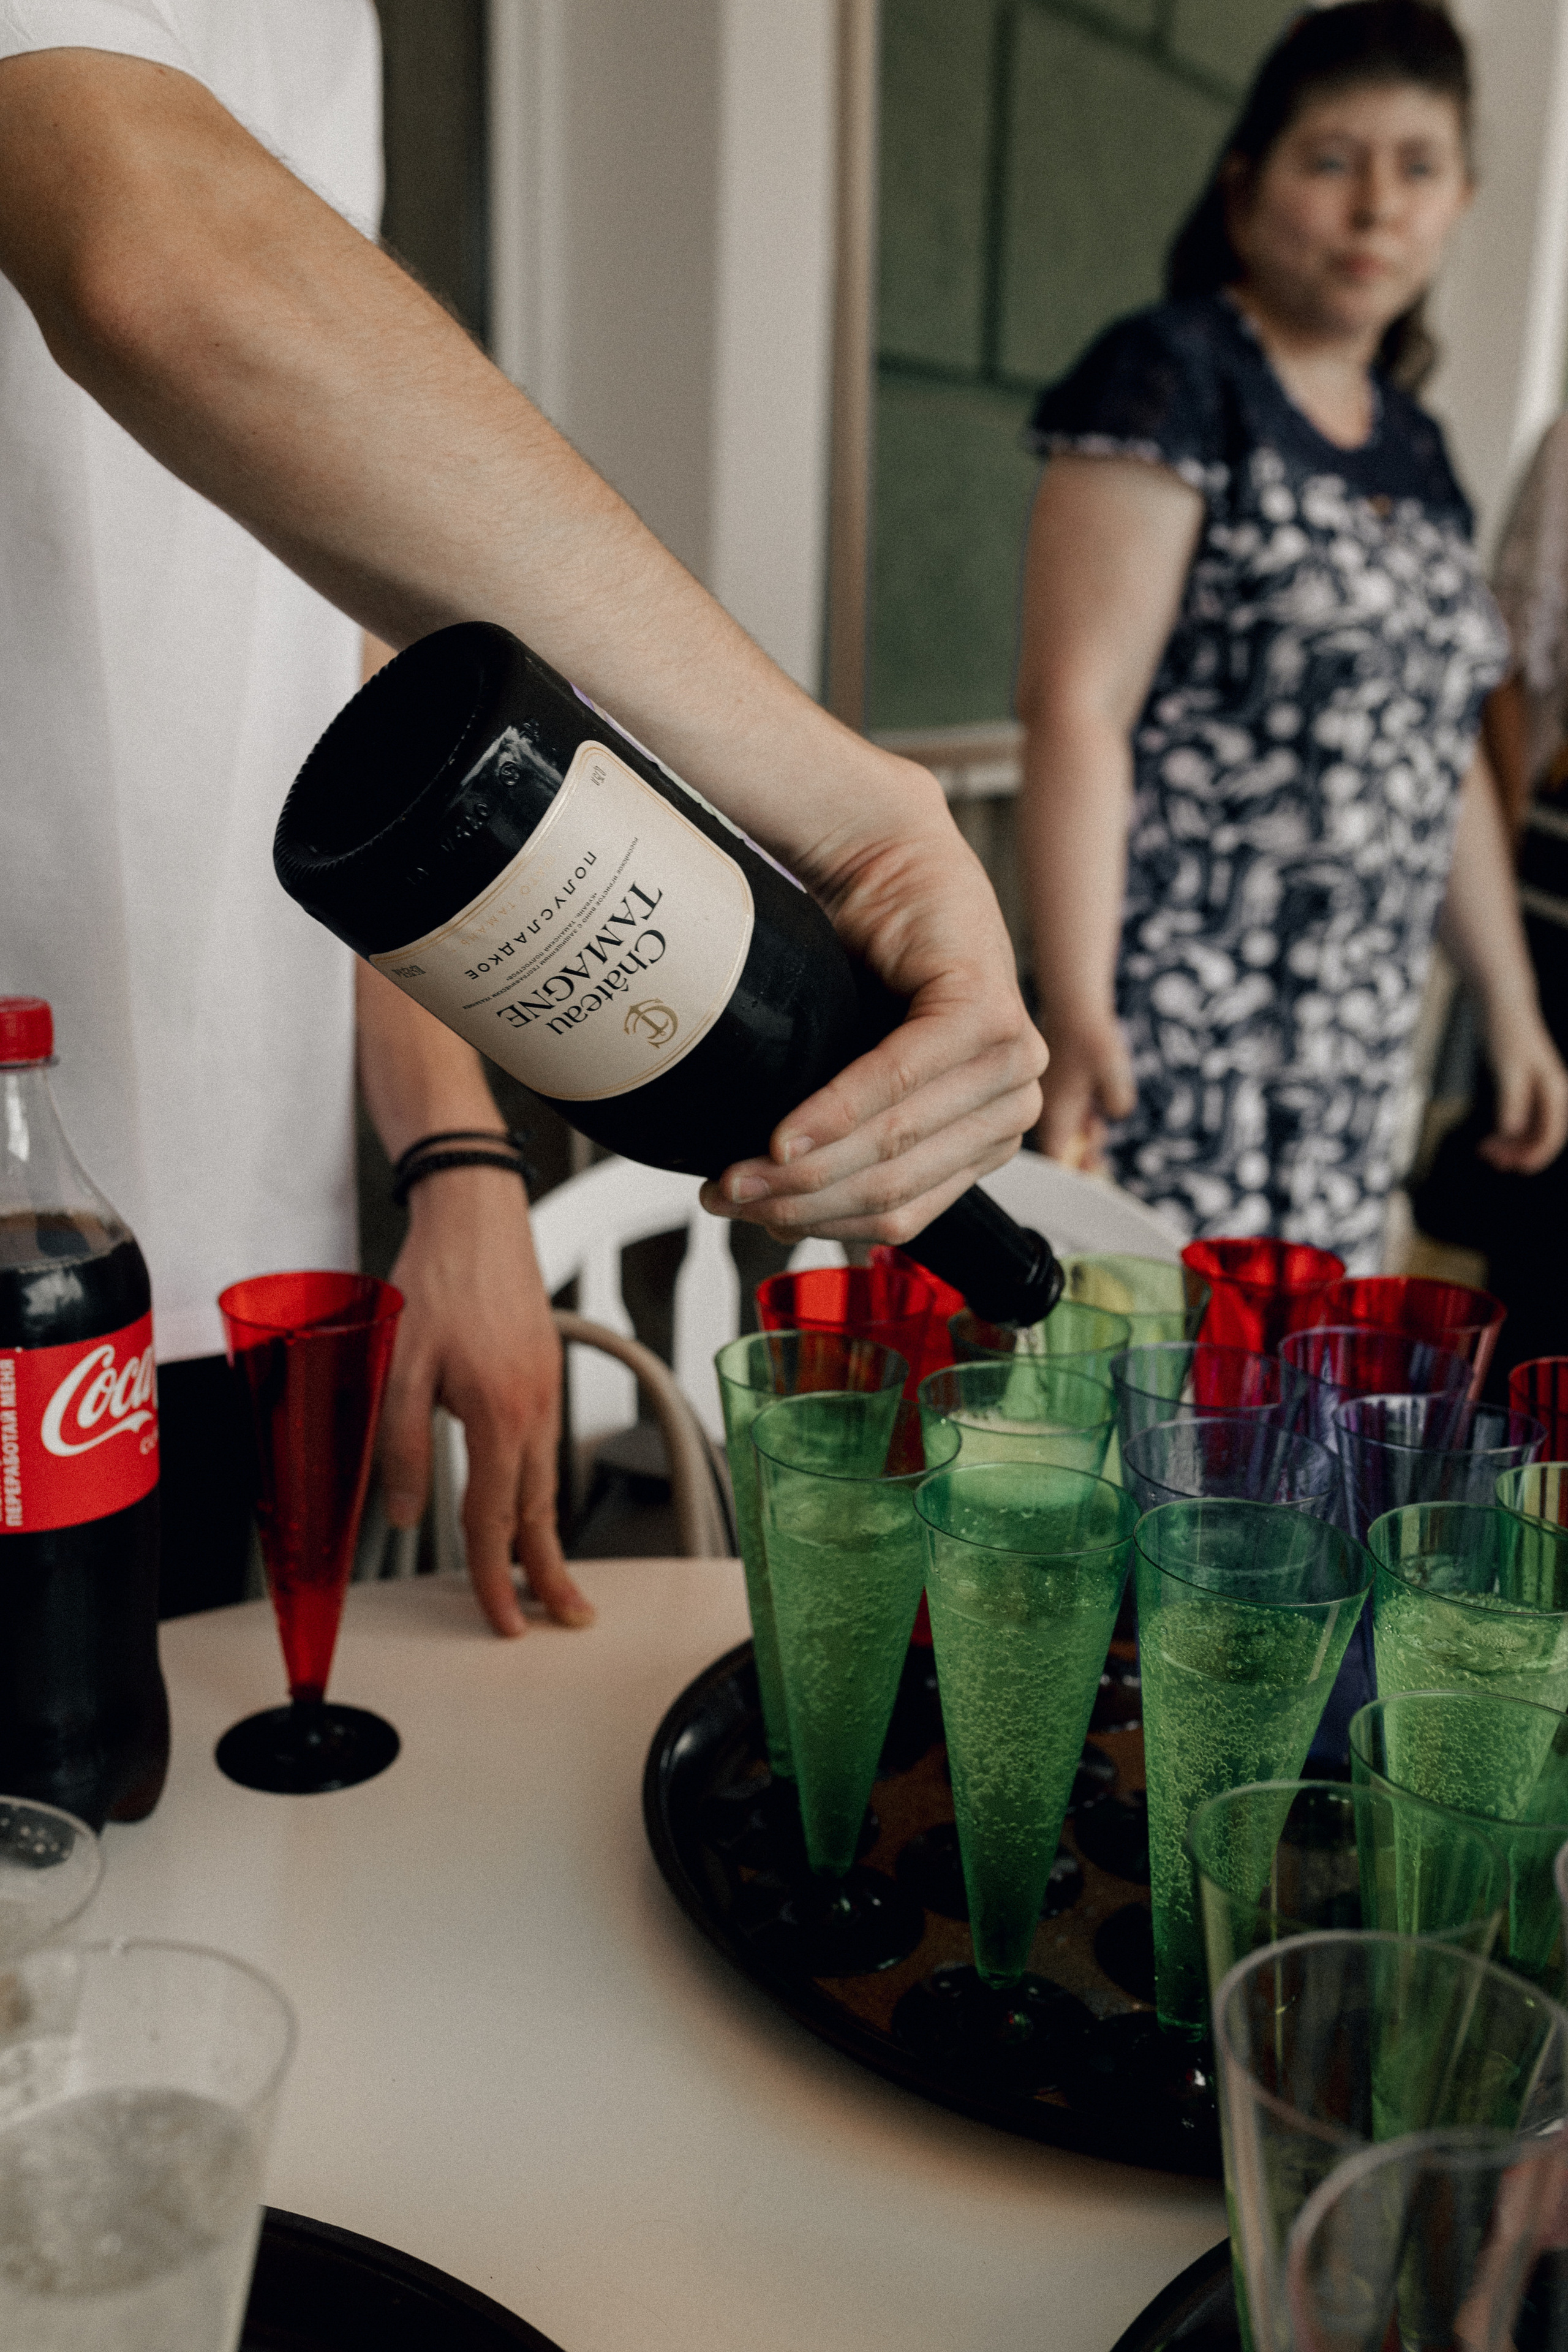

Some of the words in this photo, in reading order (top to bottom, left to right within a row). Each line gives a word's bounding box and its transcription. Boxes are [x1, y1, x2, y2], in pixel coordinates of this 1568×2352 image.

[615, 837, 638, 875] РОССИЙСКОЕ
[594, 875, 618, 907] ИГРИСТОЕ
[464, 851, 597, 980] ПОЛУСЛАДКОЕ
[581, 906, 597, 923] ВИНО
[538, 928, 578, 965] ЗАЩИЩЕННЫМ
[543, 919, 575, 952] ТАМАНСКИЙ
[496, 881, 663, 1028] TAMAGNE
[491, 964, 540, 998] ГЕОГРАФИЧЕСКИМ
[545, 929, 667, 1035] Château
